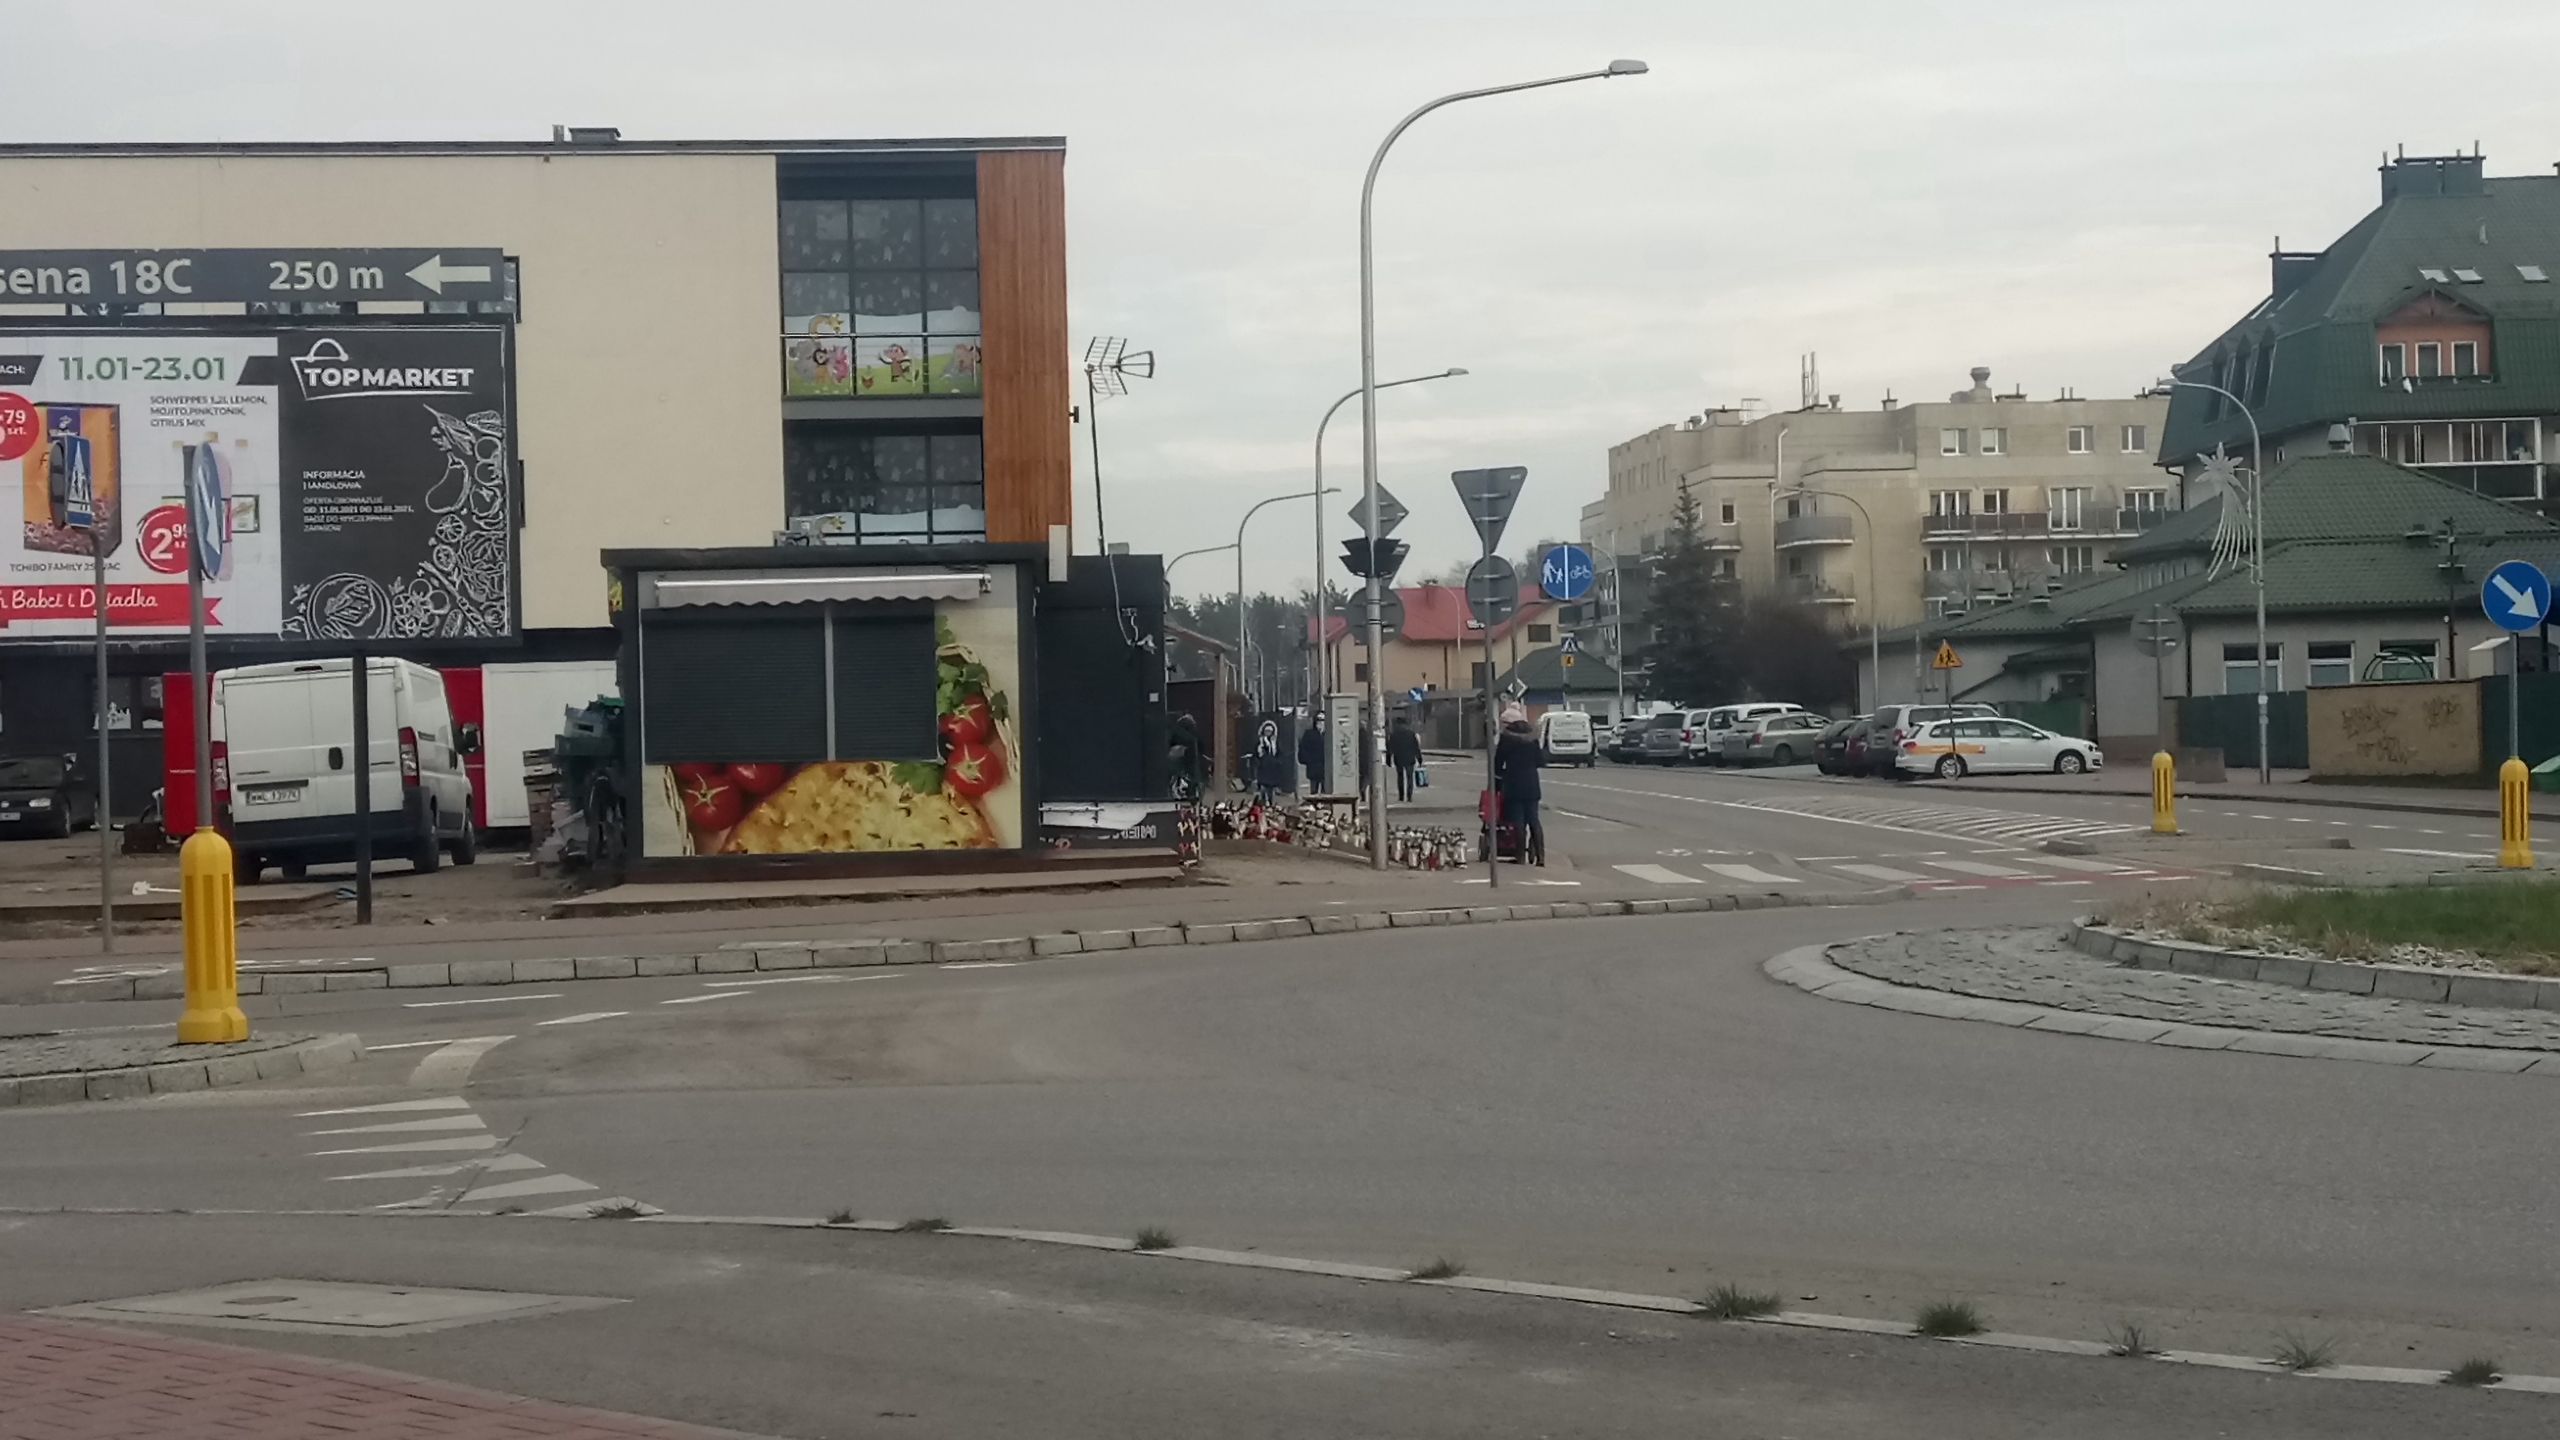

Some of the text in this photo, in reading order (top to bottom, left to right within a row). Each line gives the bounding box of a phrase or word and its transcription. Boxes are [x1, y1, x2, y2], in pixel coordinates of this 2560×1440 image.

[109, 258, 192, 295] 18C
[269, 260, 339, 290] 250
[349, 266, 384, 289] m
[59, 356, 225, 381] 11.01-23.01
[150, 418, 205, 428] CITRUS MIX
[303, 469, 366, 480] INFORMACJA
[150, 528, 174, 560] 2
[9, 563, 47, 572] TCHIBO
[12, 589, 63, 609] Babci
[80, 588, 158, 616] Diadka
